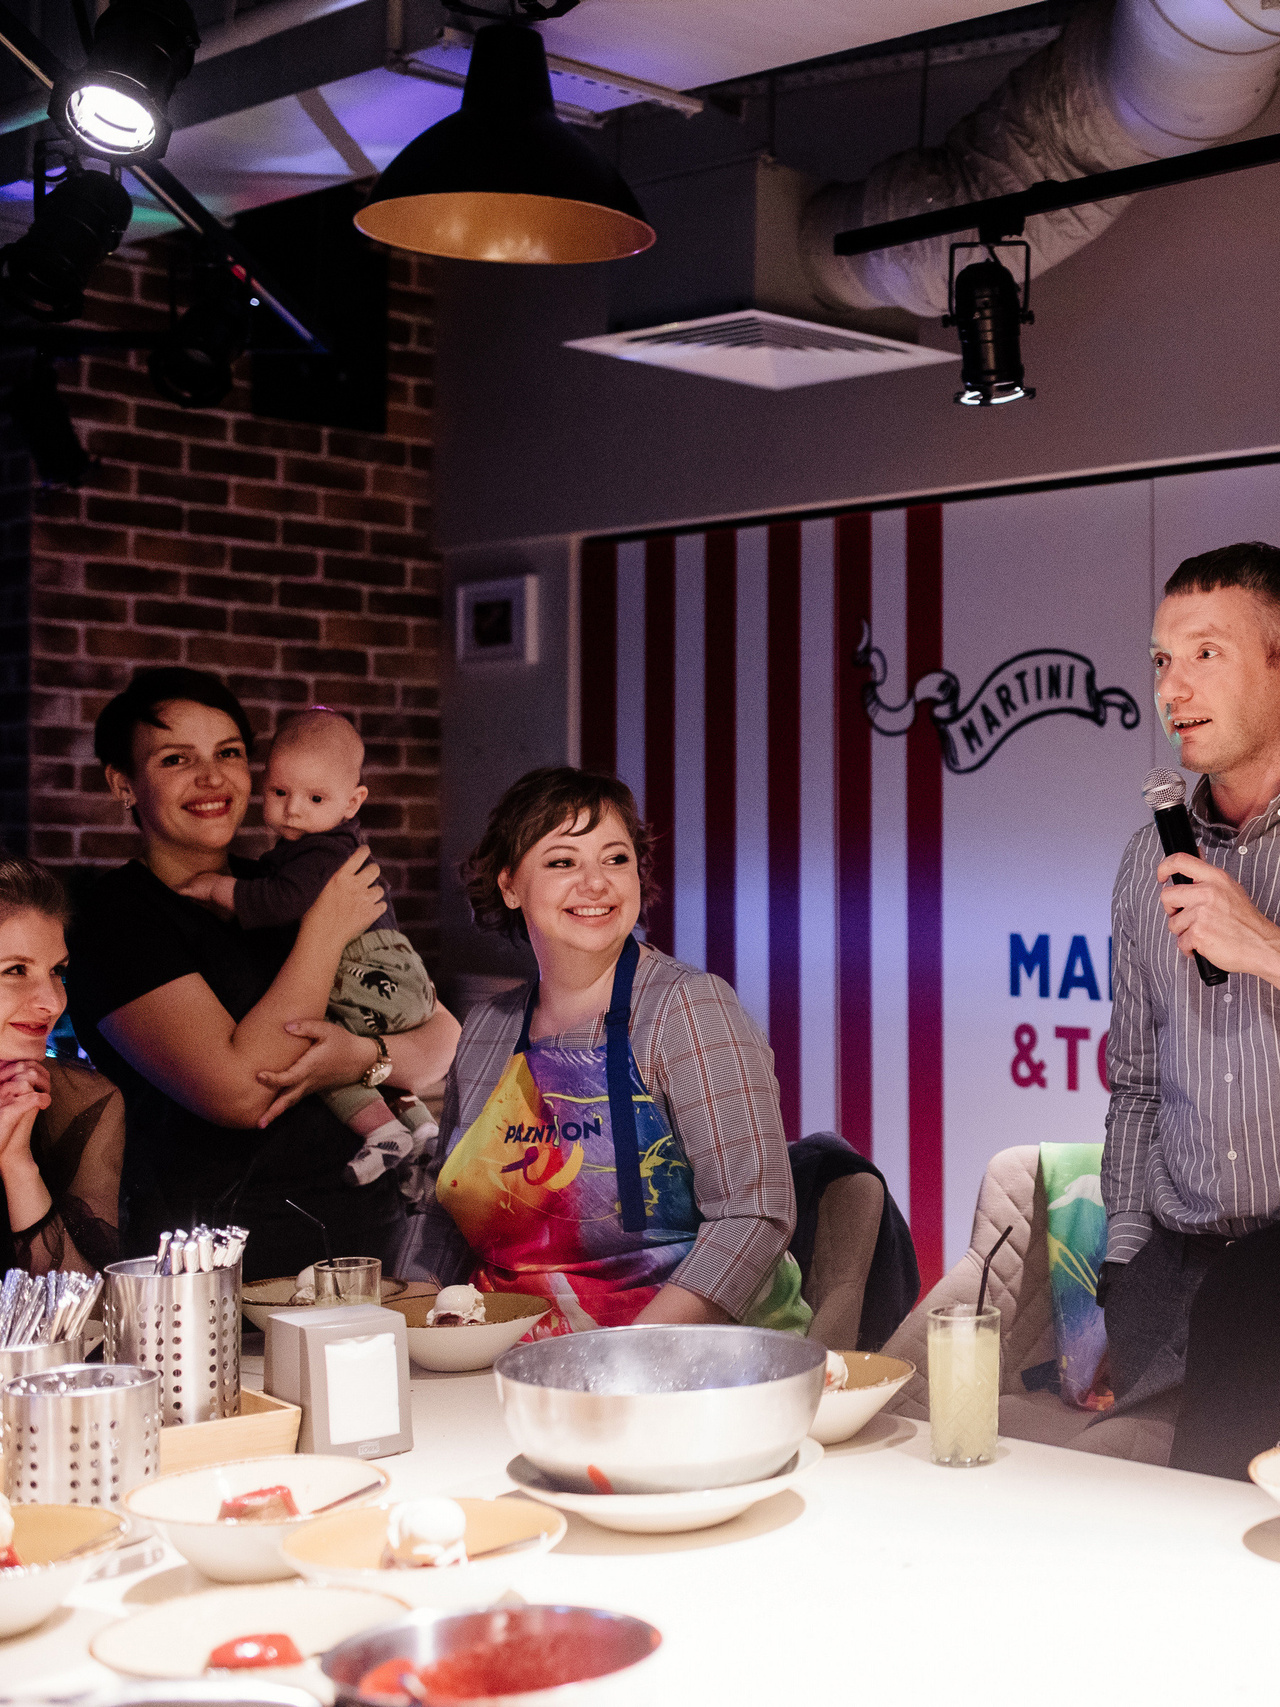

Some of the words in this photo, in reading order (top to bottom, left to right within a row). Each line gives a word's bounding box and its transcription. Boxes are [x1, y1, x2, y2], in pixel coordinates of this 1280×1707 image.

[960, 664, 1075, 754] MARTINI
[1009, 932, 1114, 1001] MA
[561, 1117, 602, 1142] ON
